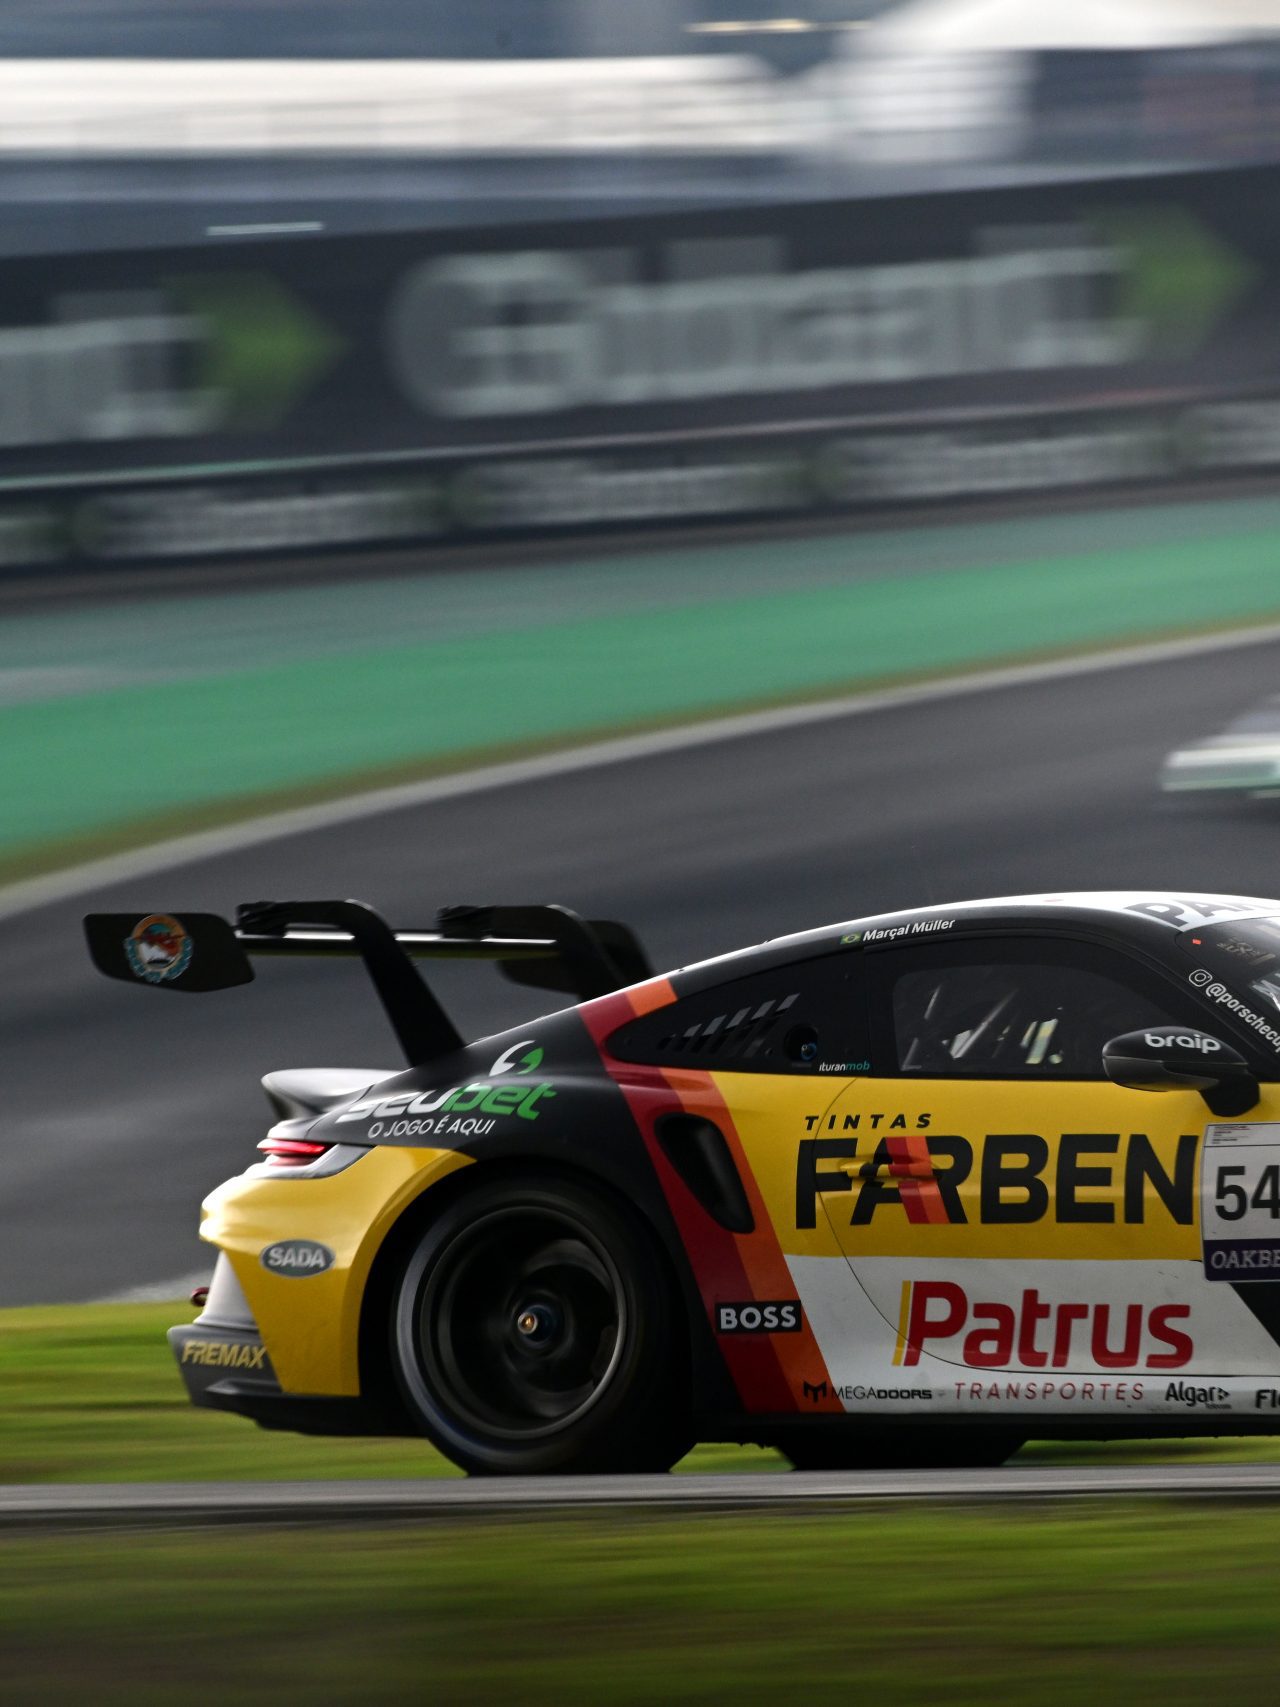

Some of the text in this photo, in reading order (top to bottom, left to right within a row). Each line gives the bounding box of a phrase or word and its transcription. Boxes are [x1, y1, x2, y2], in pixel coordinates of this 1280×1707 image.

[863, 919, 955, 943] Marçal Müller
[1144, 1033, 1221, 1055] braip
[367, 1114, 496, 1139] O JOGO É AQUI
[804, 1112, 932, 1131] TINTAS
[795, 1133, 1199, 1229] FARBEN
[267, 1246, 327, 1269] SADA
[719, 1304, 798, 1330] BOSS
[902, 1281, 1195, 1369] Patrus
[181, 1338, 267, 1369] FREMAX
[831, 1385, 933, 1400] MEGADOORS
[953, 1382, 1144, 1401] TRANSPORTES
[1164, 1380, 1217, 1407] Algar
